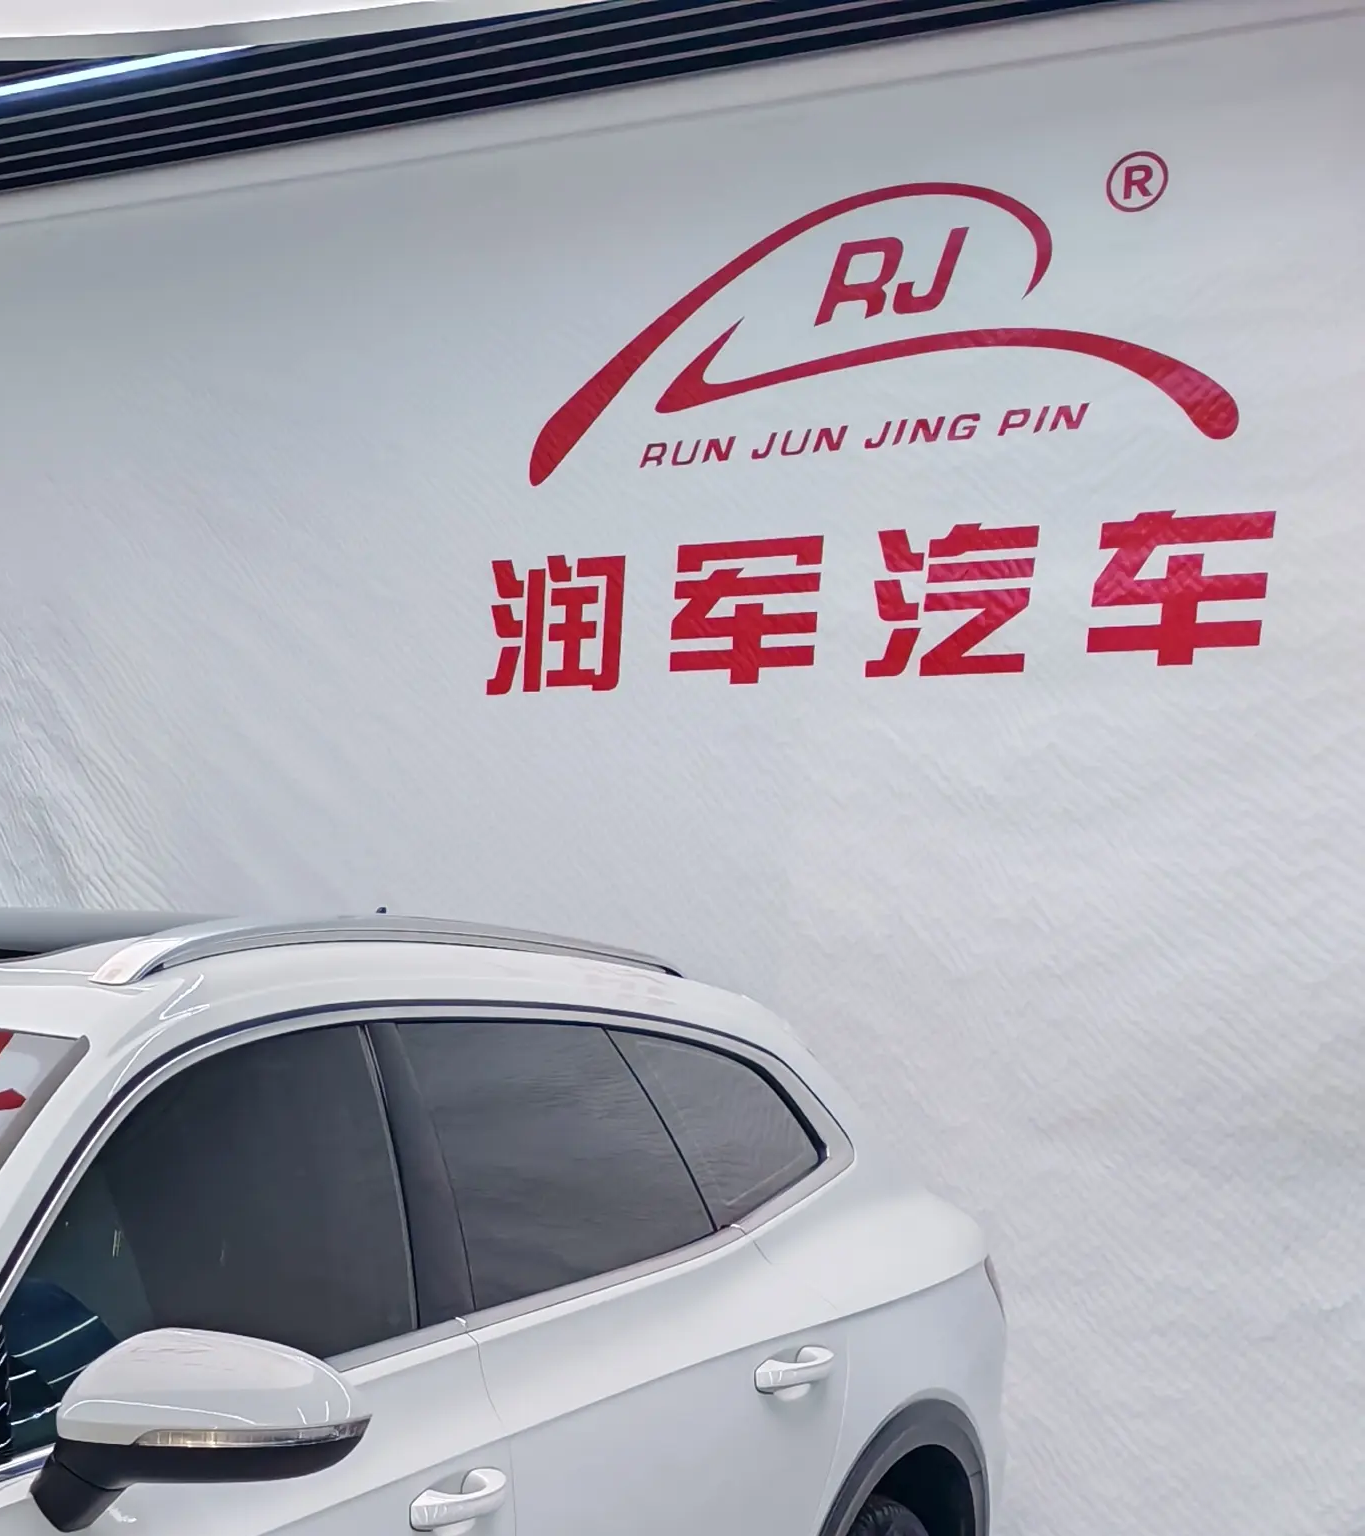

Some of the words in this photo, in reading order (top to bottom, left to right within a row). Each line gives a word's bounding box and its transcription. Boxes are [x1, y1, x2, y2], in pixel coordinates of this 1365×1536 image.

[814, 226, 970, 327] RJ
[639, 436, 736, 469] RUN
[750, 424, 849, 461] JUN
[862, 413, 981, 451] JING
[998, 402, 1091, 436] PIN
[485, 510, 1277, 696] 润军汽车
